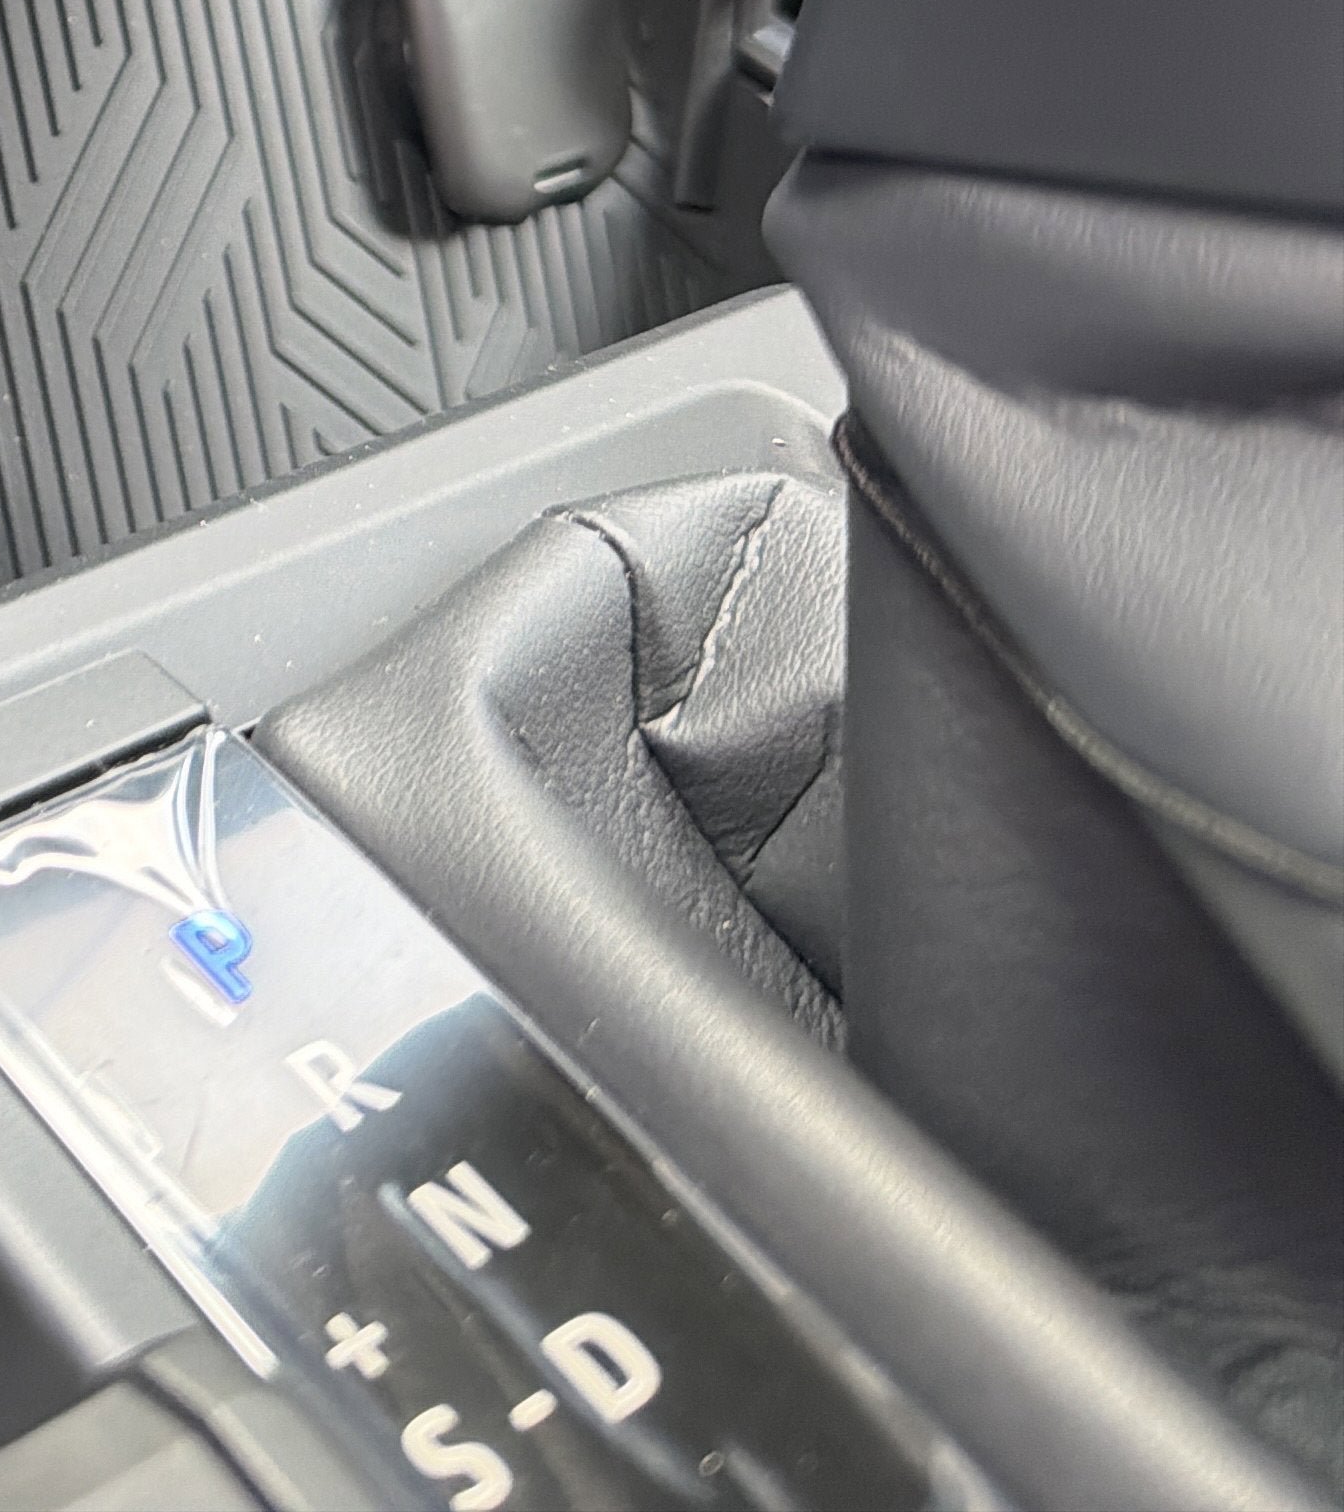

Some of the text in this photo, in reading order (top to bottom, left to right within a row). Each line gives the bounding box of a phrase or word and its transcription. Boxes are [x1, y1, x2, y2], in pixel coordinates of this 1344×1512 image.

[167, 907, 253, 1005] P
[284, 1039, 404, 1134] R
[407, 1159, 532, 1270] N
[538, 1310, 662, 1425] D
[400, 1402, 514, 1512] S
